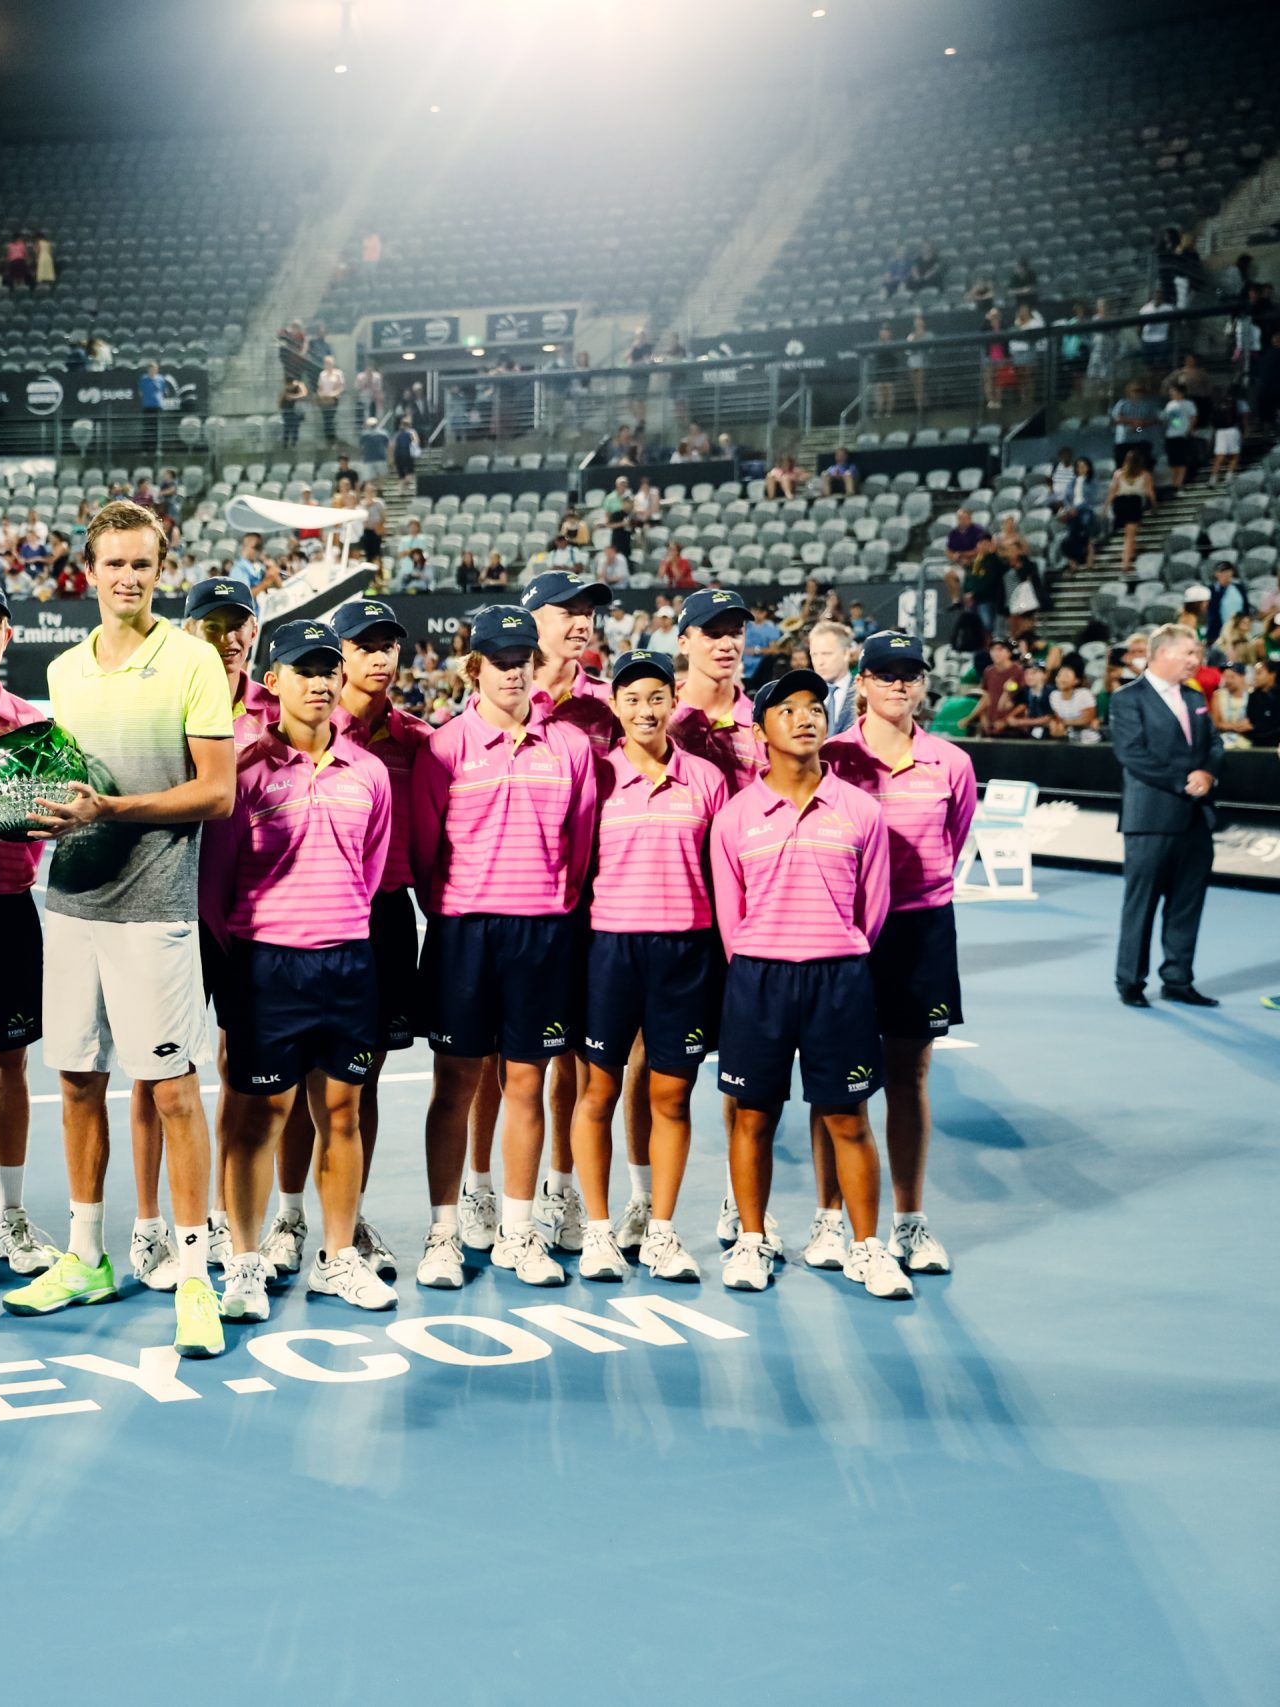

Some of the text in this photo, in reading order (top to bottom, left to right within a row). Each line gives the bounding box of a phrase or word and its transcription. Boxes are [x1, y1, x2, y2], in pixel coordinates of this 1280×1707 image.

[38, 611, 62, 628] Fly
[12, 625, 89, 644] Emirates
[463, 758, 490, 771] BLK
[266, 779, 294, 794] BLK
[747, 823, 774, 837] BLK
[251, 1073, 281, 1084] BLK
[721, 1071, 745, 1087] BLK
